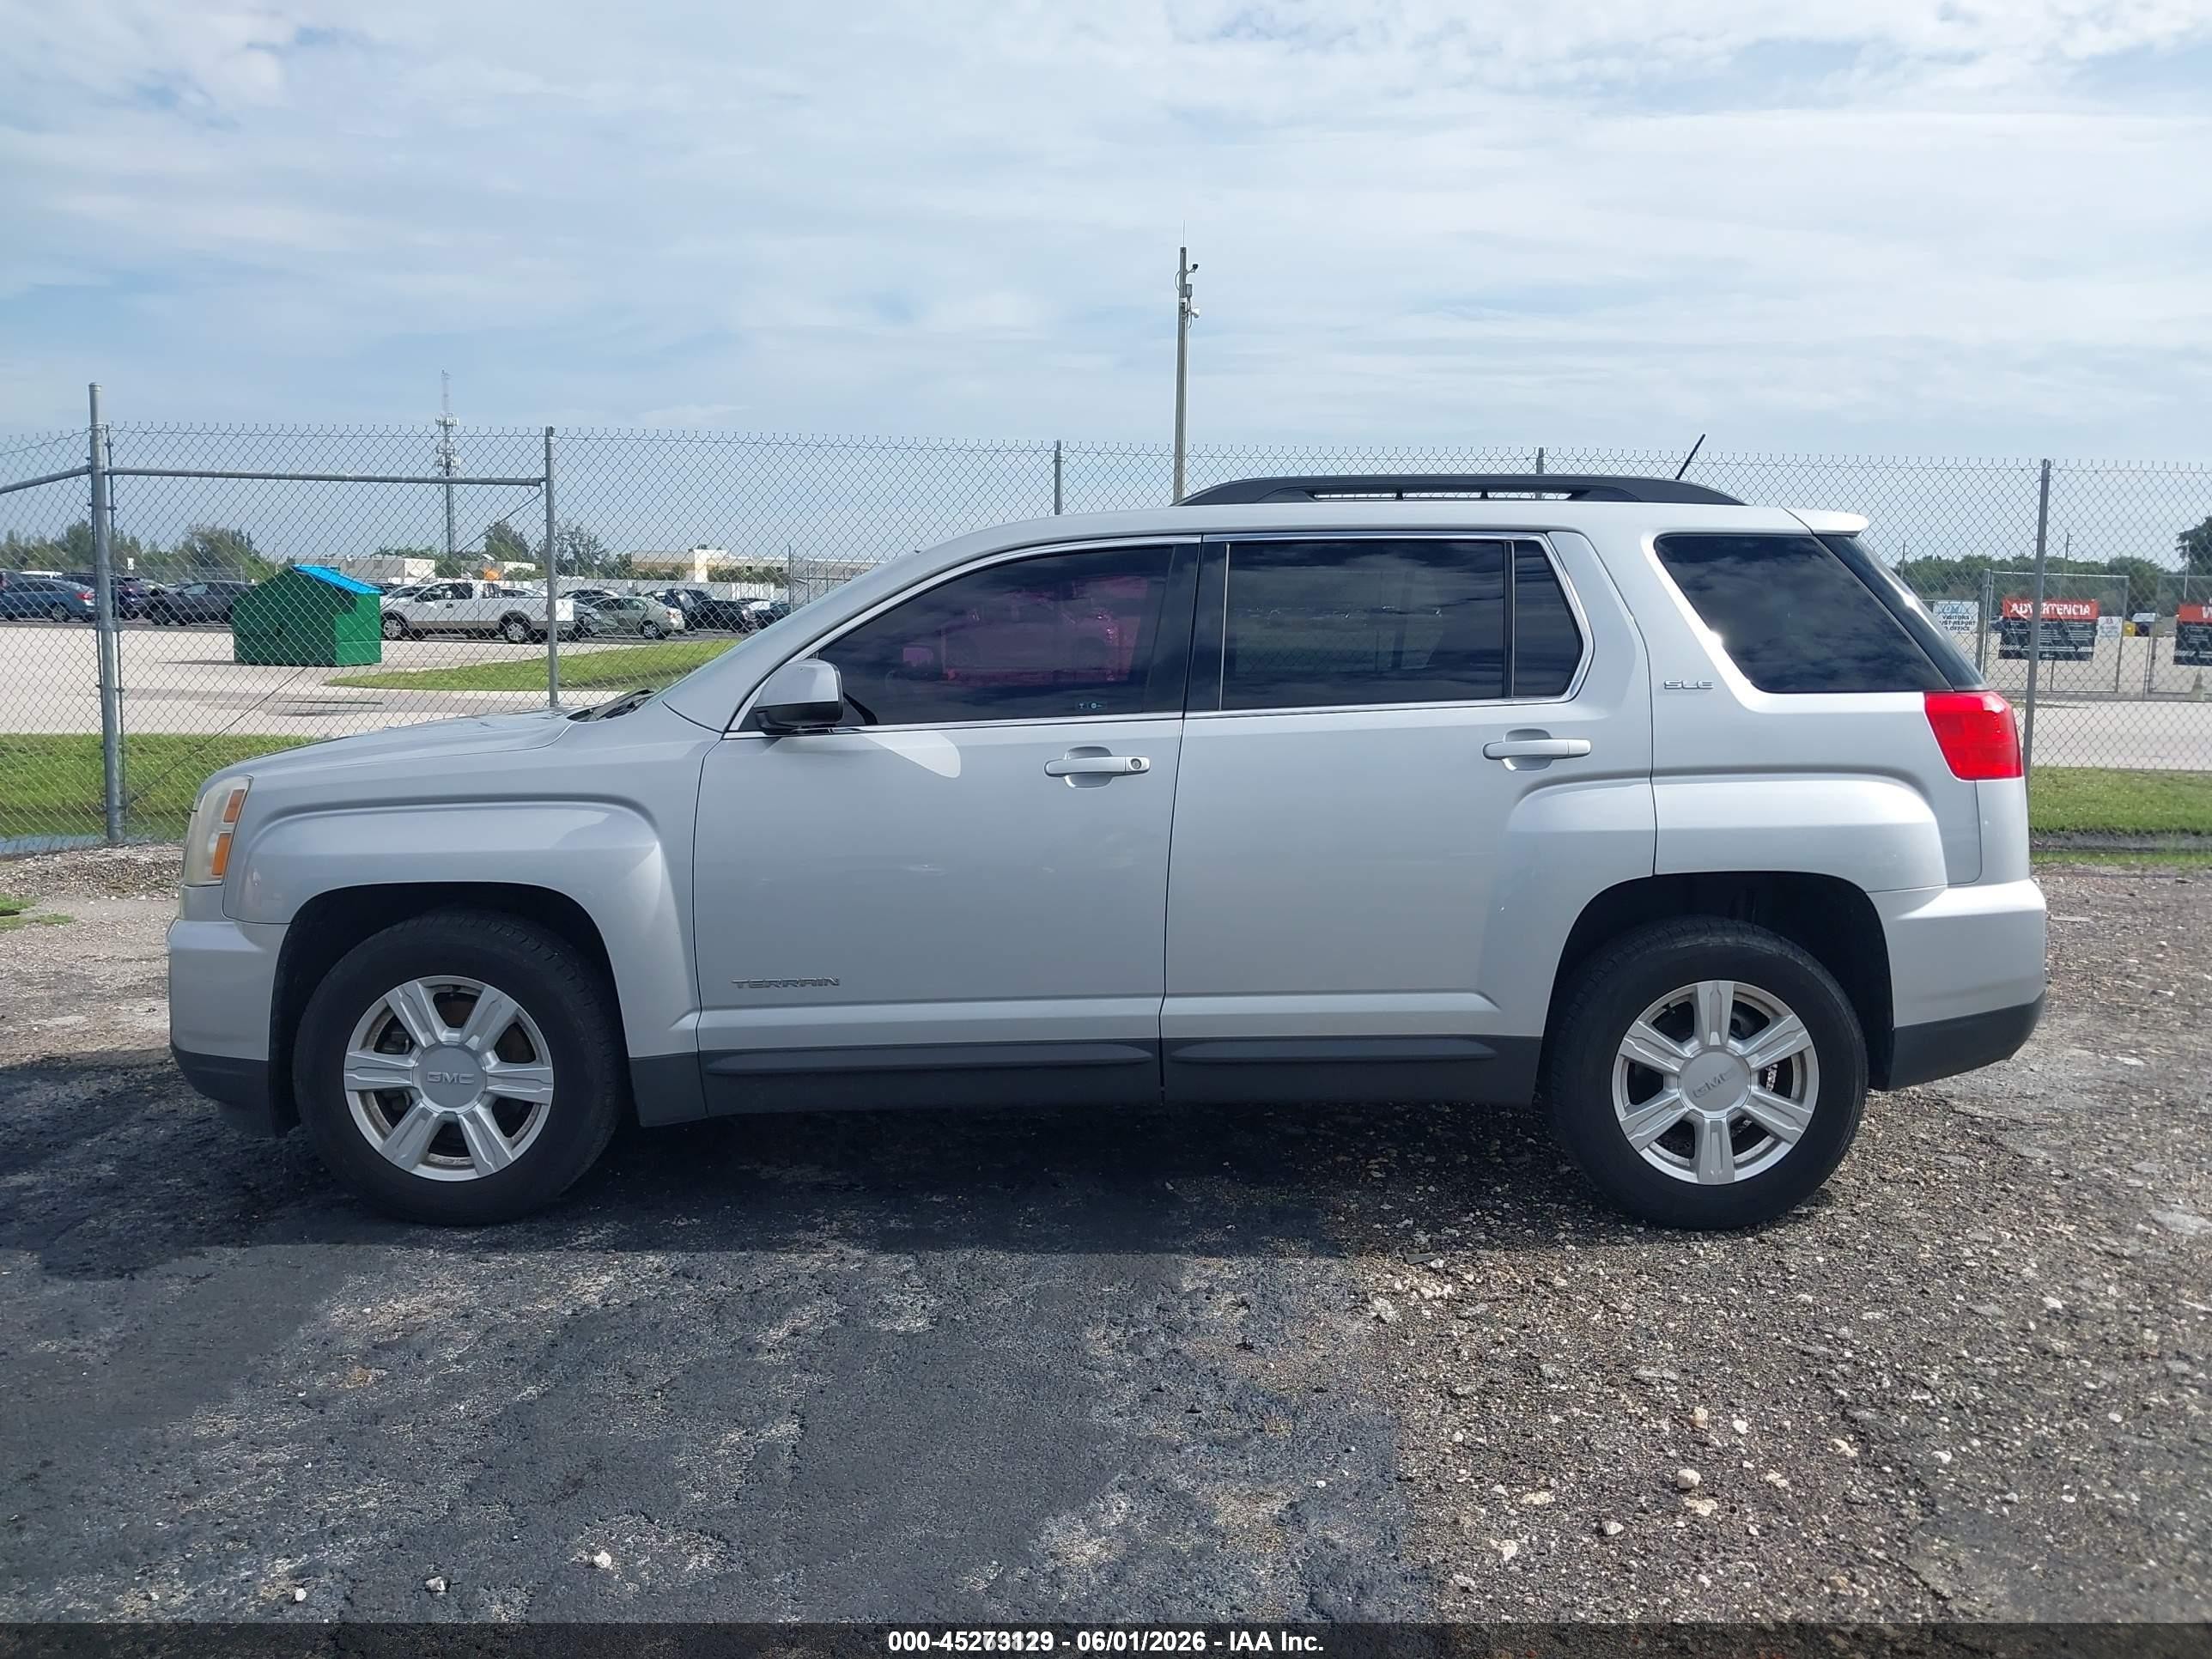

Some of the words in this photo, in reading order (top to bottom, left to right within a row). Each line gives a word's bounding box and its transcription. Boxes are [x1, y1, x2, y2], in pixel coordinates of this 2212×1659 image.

[2009, 602, 2091, 616] ADVRTENCIA
[1663, 680, 1714, 690] SLE
[731, 977, 841, 988] TERRAIN
[427, 1071, 475, 1085] GMC
[1692, 1066, 1735, 1098] GMC
